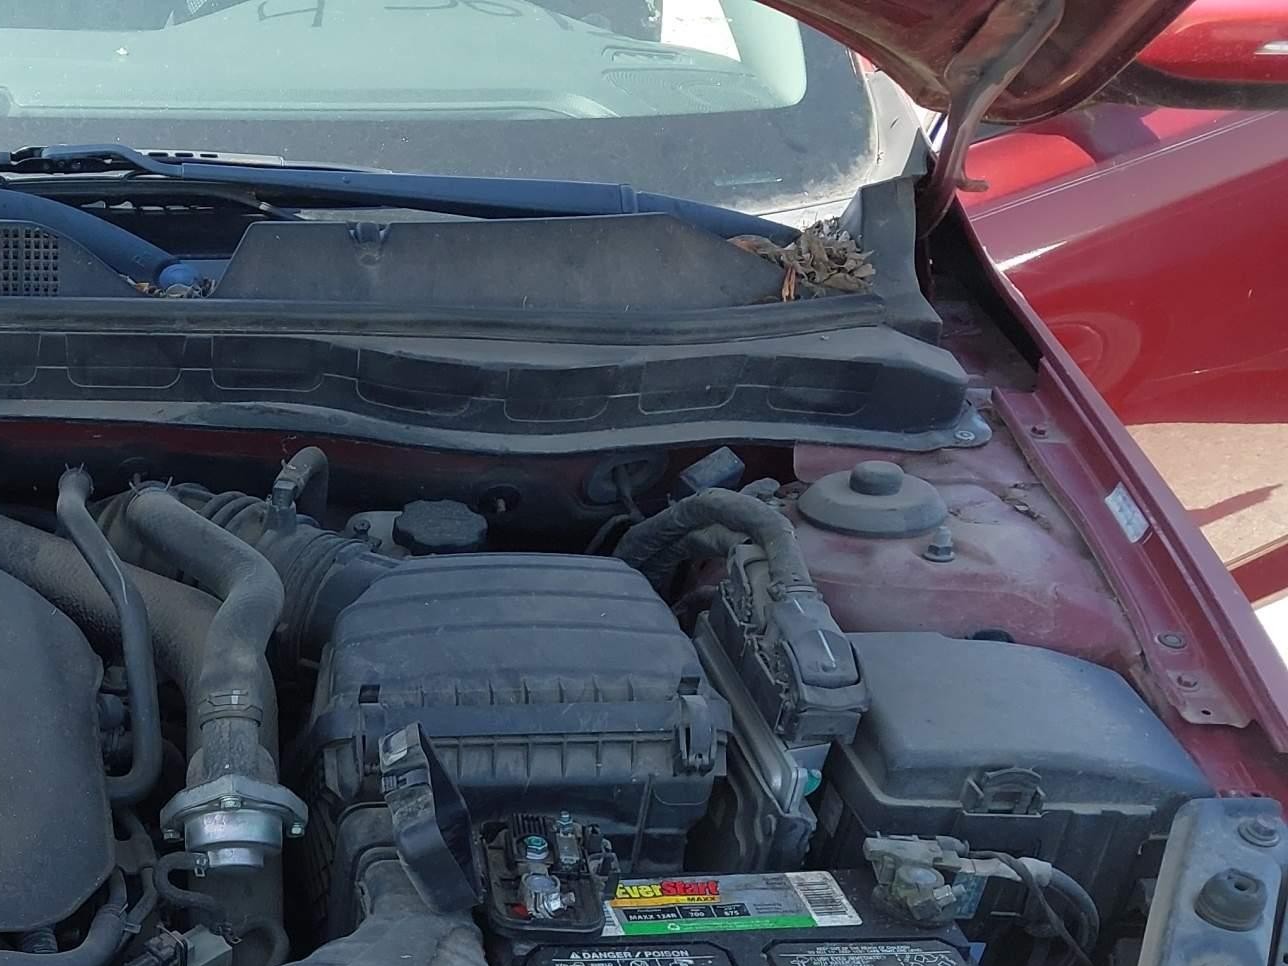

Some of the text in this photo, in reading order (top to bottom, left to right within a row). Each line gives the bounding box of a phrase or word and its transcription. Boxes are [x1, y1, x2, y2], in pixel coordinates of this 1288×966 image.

[615, 879, 720, 900] EverStart
[582, 951, 632, 959] DANGER
[644, 950, 689, 958] POISON
